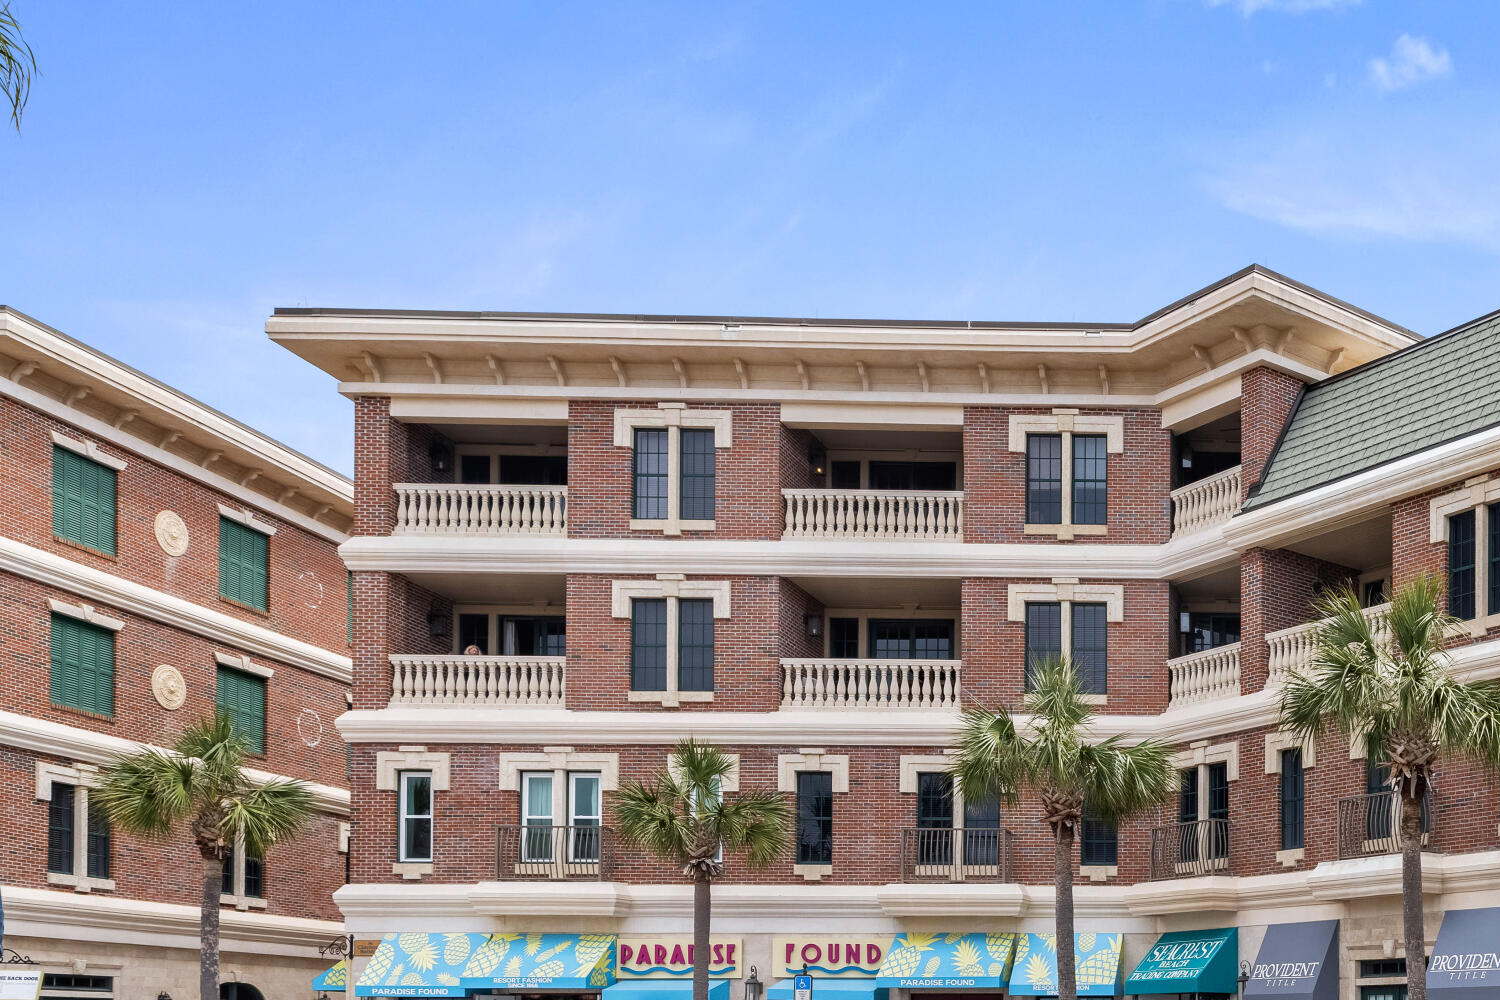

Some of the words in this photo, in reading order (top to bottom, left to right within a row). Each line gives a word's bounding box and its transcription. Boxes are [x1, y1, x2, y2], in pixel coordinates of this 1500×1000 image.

[785, 944, 882, 964] FOUND
[1147, 941, 1223, 962] SEACREST
[1159, 960, 1190, 968] BEACH
[1252, 962, 1320, 978] PROVIDENT
[1129, 972, 1162, 980] TRADING
[1163, 970, 1200, 979] COMPANY
[1450, 971, 1487, 980] TITLE
[1266, 979, 1296, 987] TITLE
[372, 988, 415, 996] PARADISE
[418, 988, 449, 996] FOUND
